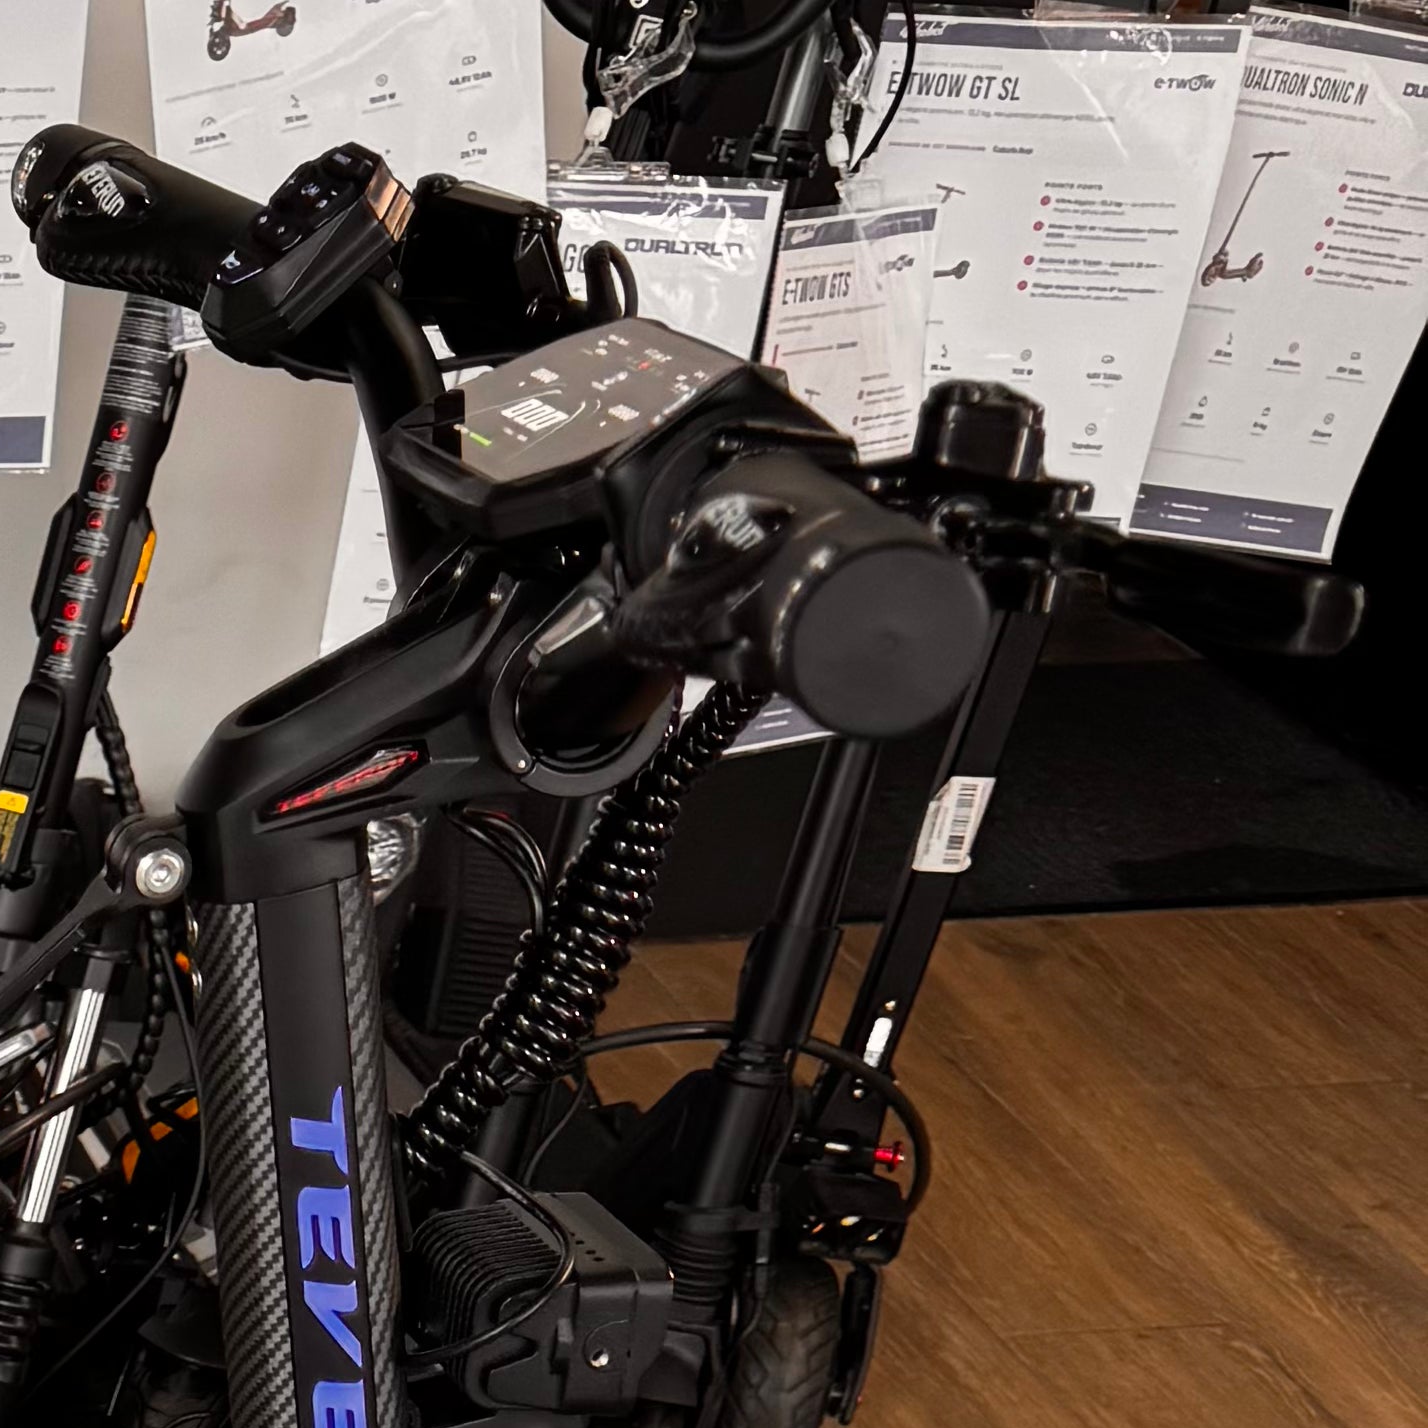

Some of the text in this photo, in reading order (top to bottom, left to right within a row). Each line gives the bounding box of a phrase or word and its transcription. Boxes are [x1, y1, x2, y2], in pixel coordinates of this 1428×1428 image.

[887, 71, 1020, 101] ETWOW GT SL
[1243, 65, 1369, 106] UALTRON SONIC N
[829, 272, 851, 298] GTS
